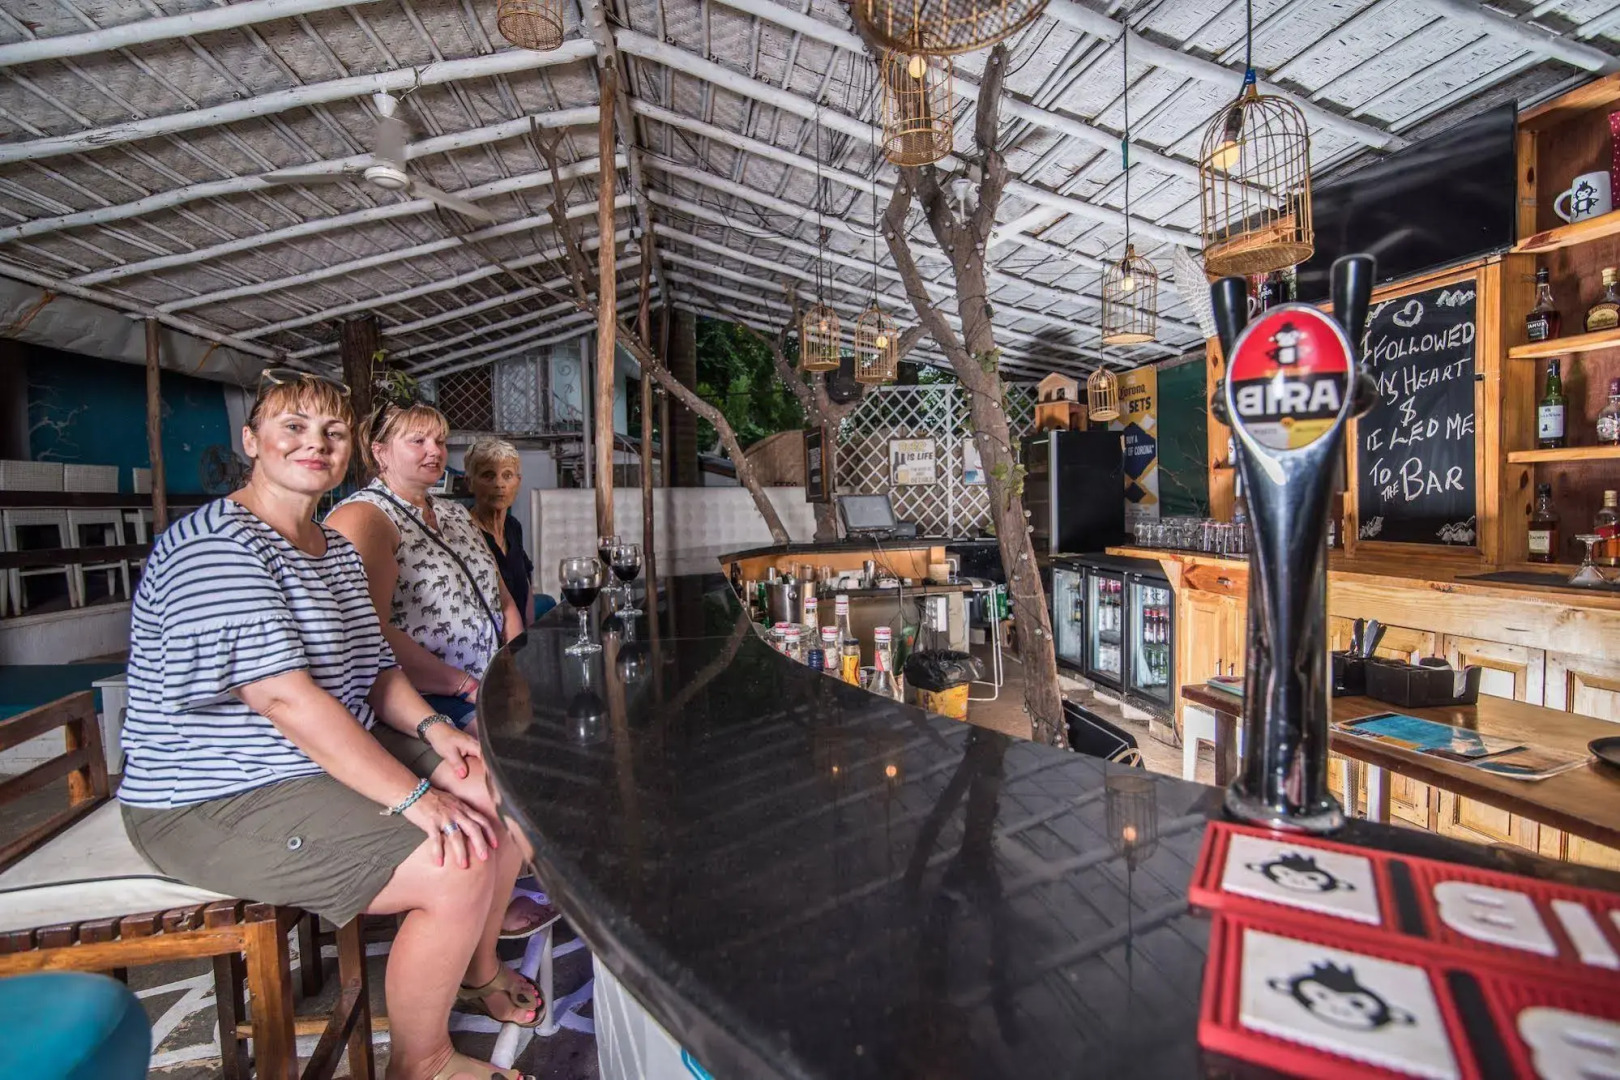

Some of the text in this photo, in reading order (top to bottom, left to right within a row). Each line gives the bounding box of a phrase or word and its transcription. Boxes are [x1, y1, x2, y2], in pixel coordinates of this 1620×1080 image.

[1360, 321, 1475, 367] I FOLLOWED
[1403, 357, 1471, 396] HEART
[1236, 378, 1341, 417] BIRA
[1389, 416, 1438, 450] LED
[1446, 412, 1475, 441] ME
[907, 451, 934, 461] IS LIFE
[1369, 456, 1465, 502] TO THE BAR
[1433, 880, 1620, 972] BI
